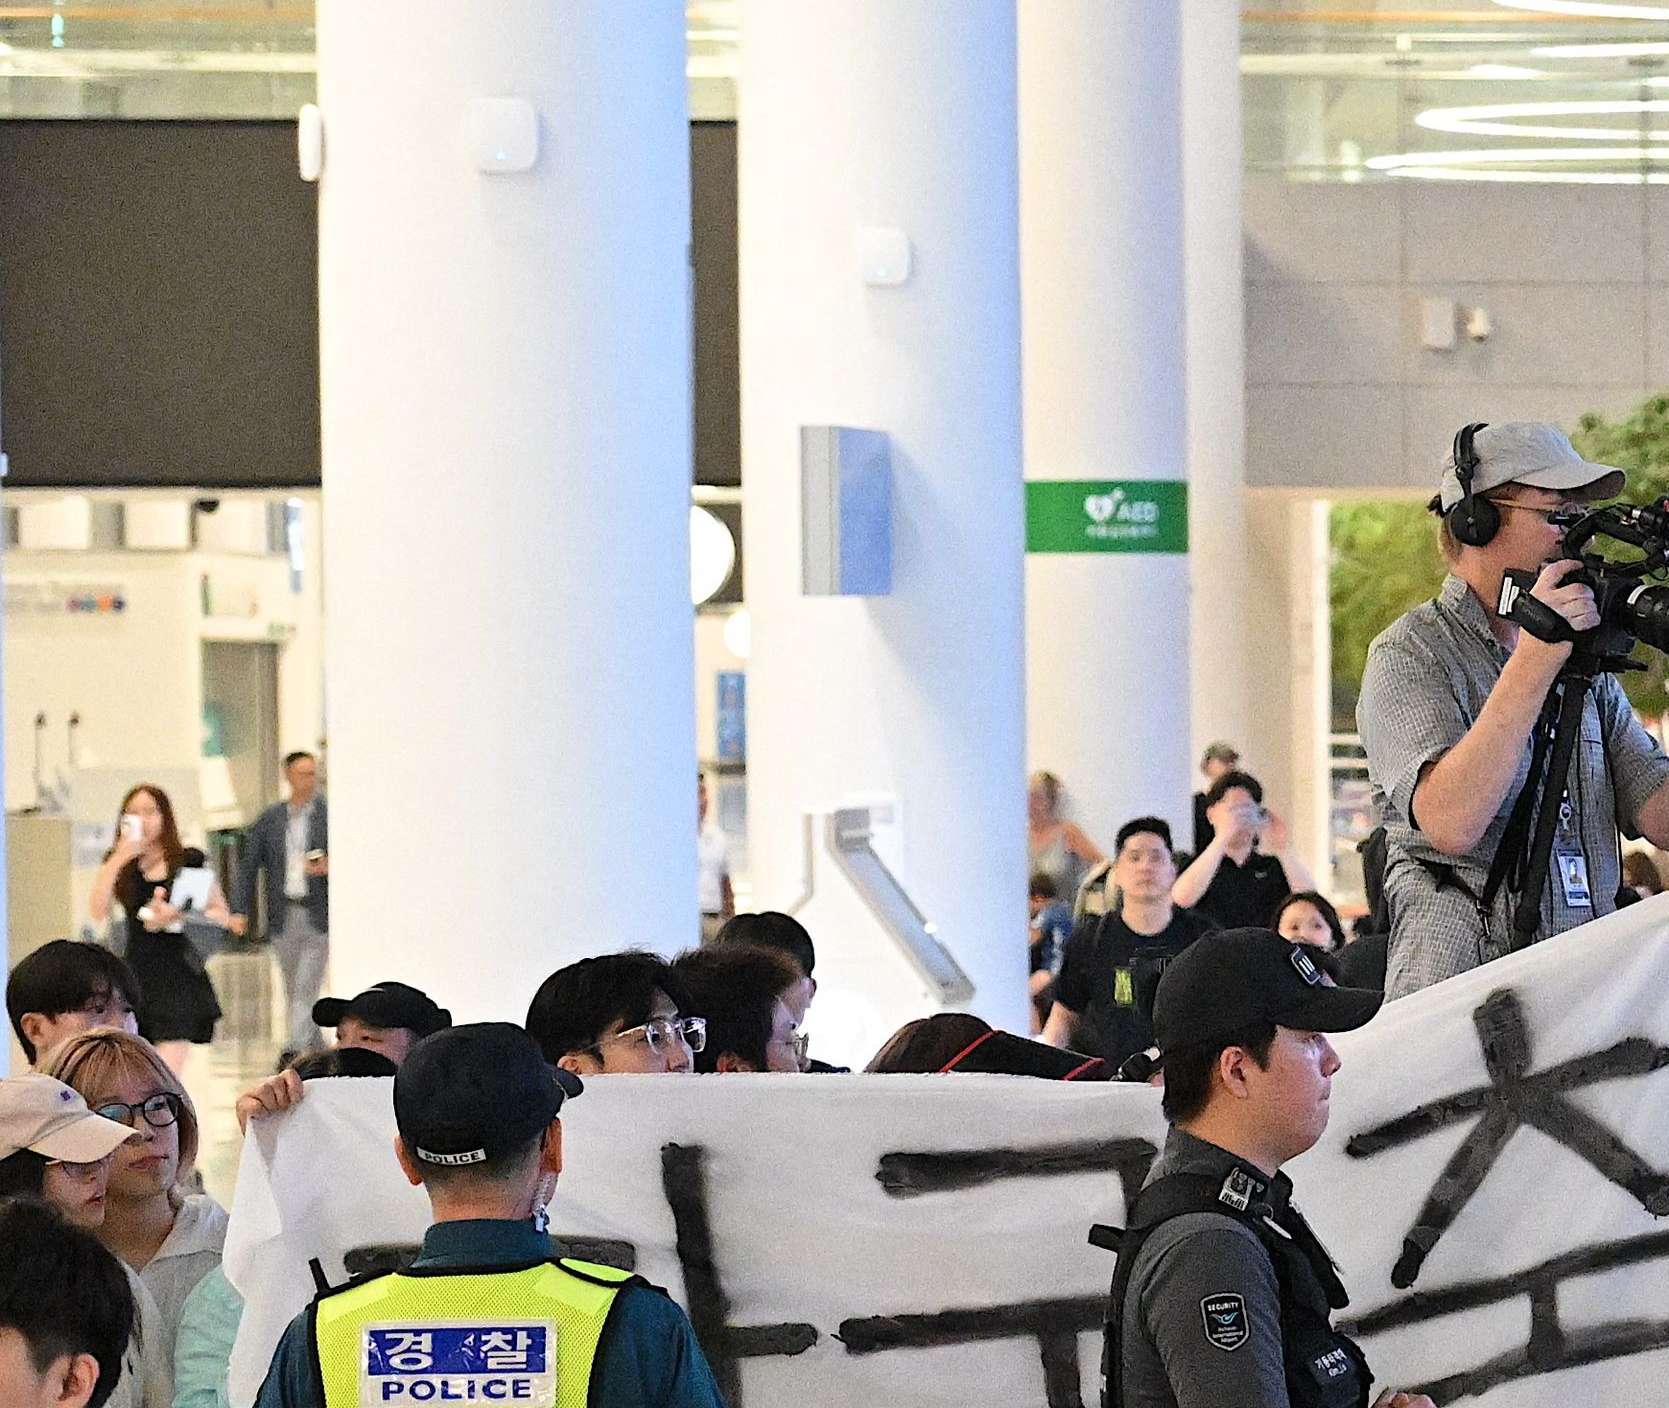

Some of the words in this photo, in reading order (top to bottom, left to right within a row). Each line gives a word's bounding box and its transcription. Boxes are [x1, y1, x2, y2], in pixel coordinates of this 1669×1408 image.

[423, 1151, 482, 1165] POLICE
[1207, 1302, 1239, 1312] SECURITY
[382, 1378, 532, 1400] POLICE
